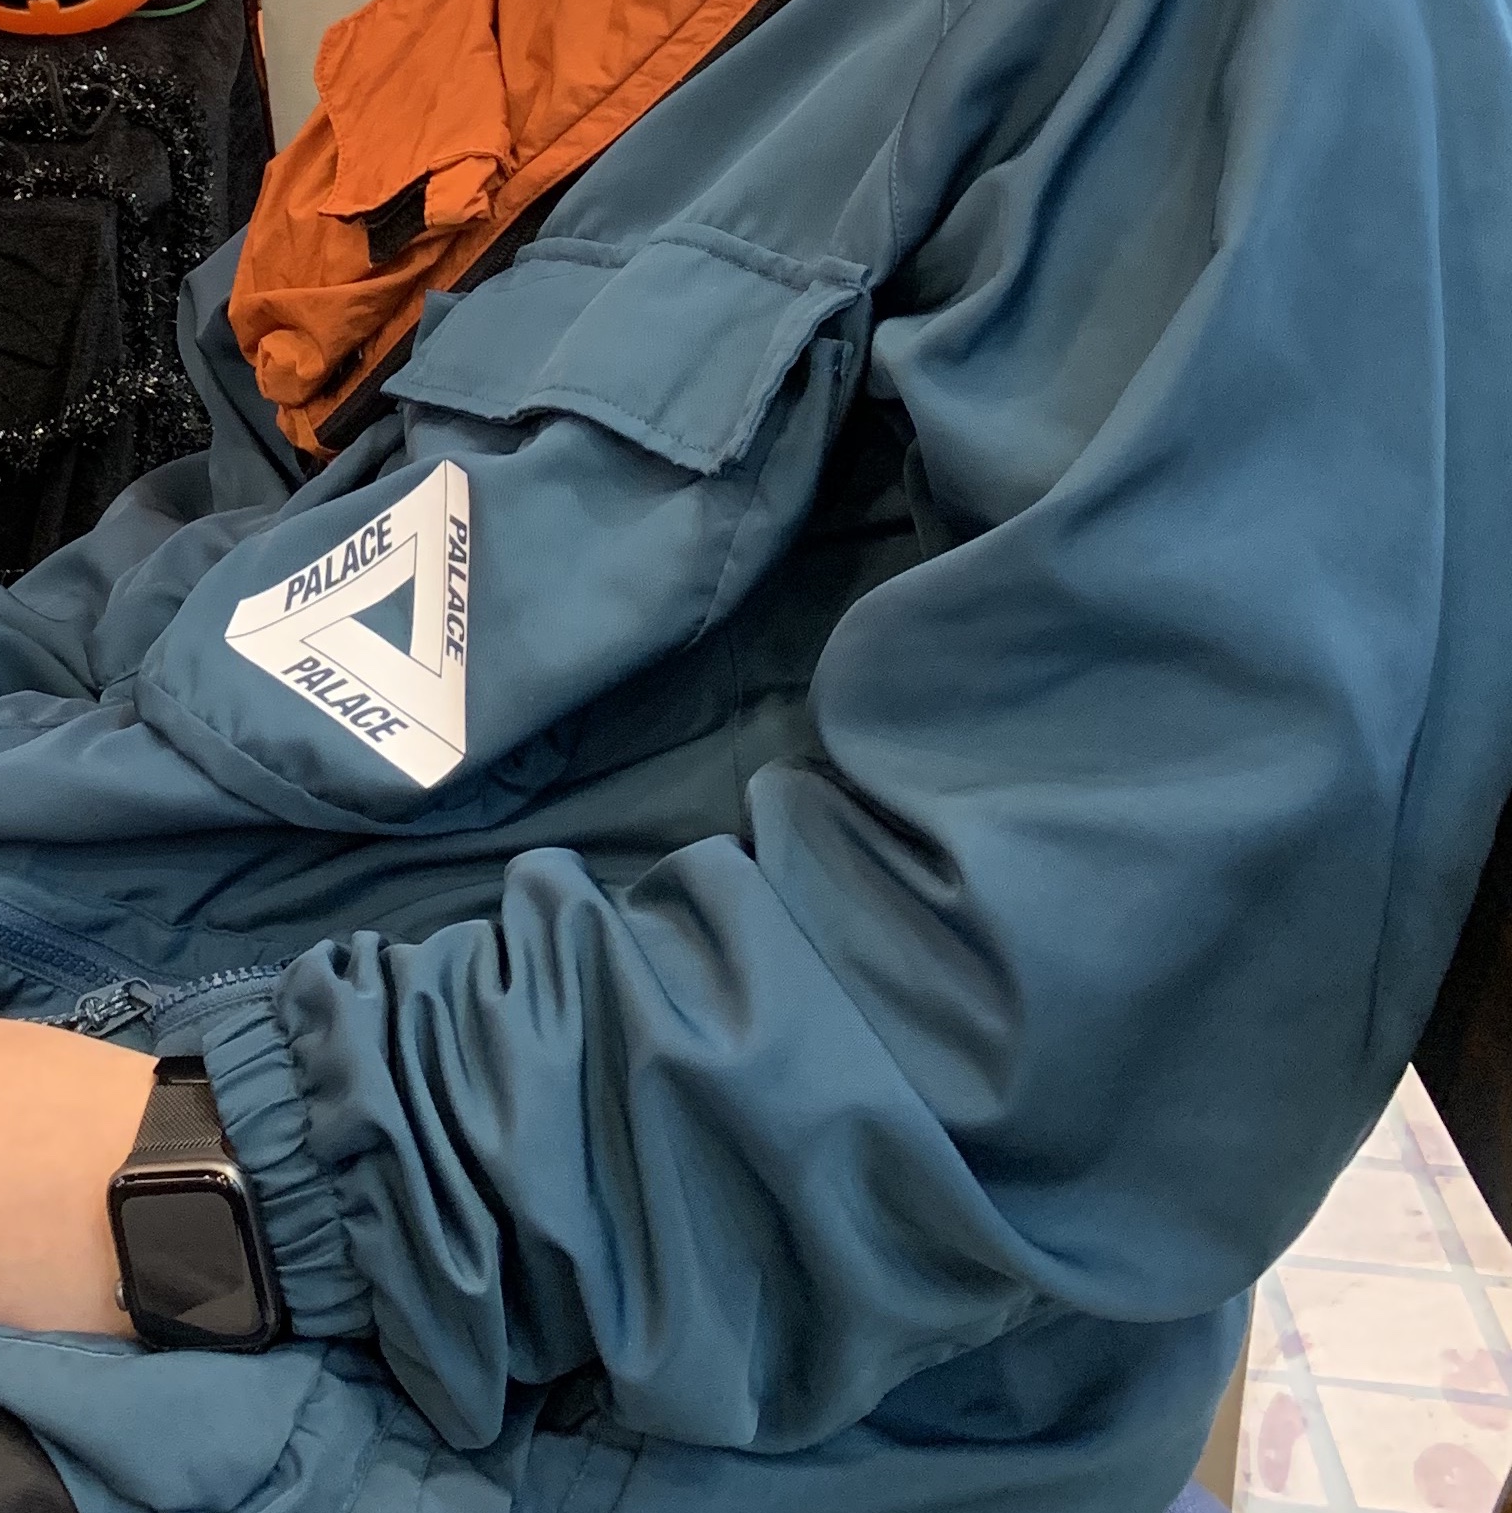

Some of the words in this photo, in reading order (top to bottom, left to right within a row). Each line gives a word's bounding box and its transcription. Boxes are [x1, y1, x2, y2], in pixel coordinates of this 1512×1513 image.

[283, 512, 393, 612] PALACE
[445, 514, 469, 667] PALACE
[280, 655, 410, 744] PALACE
